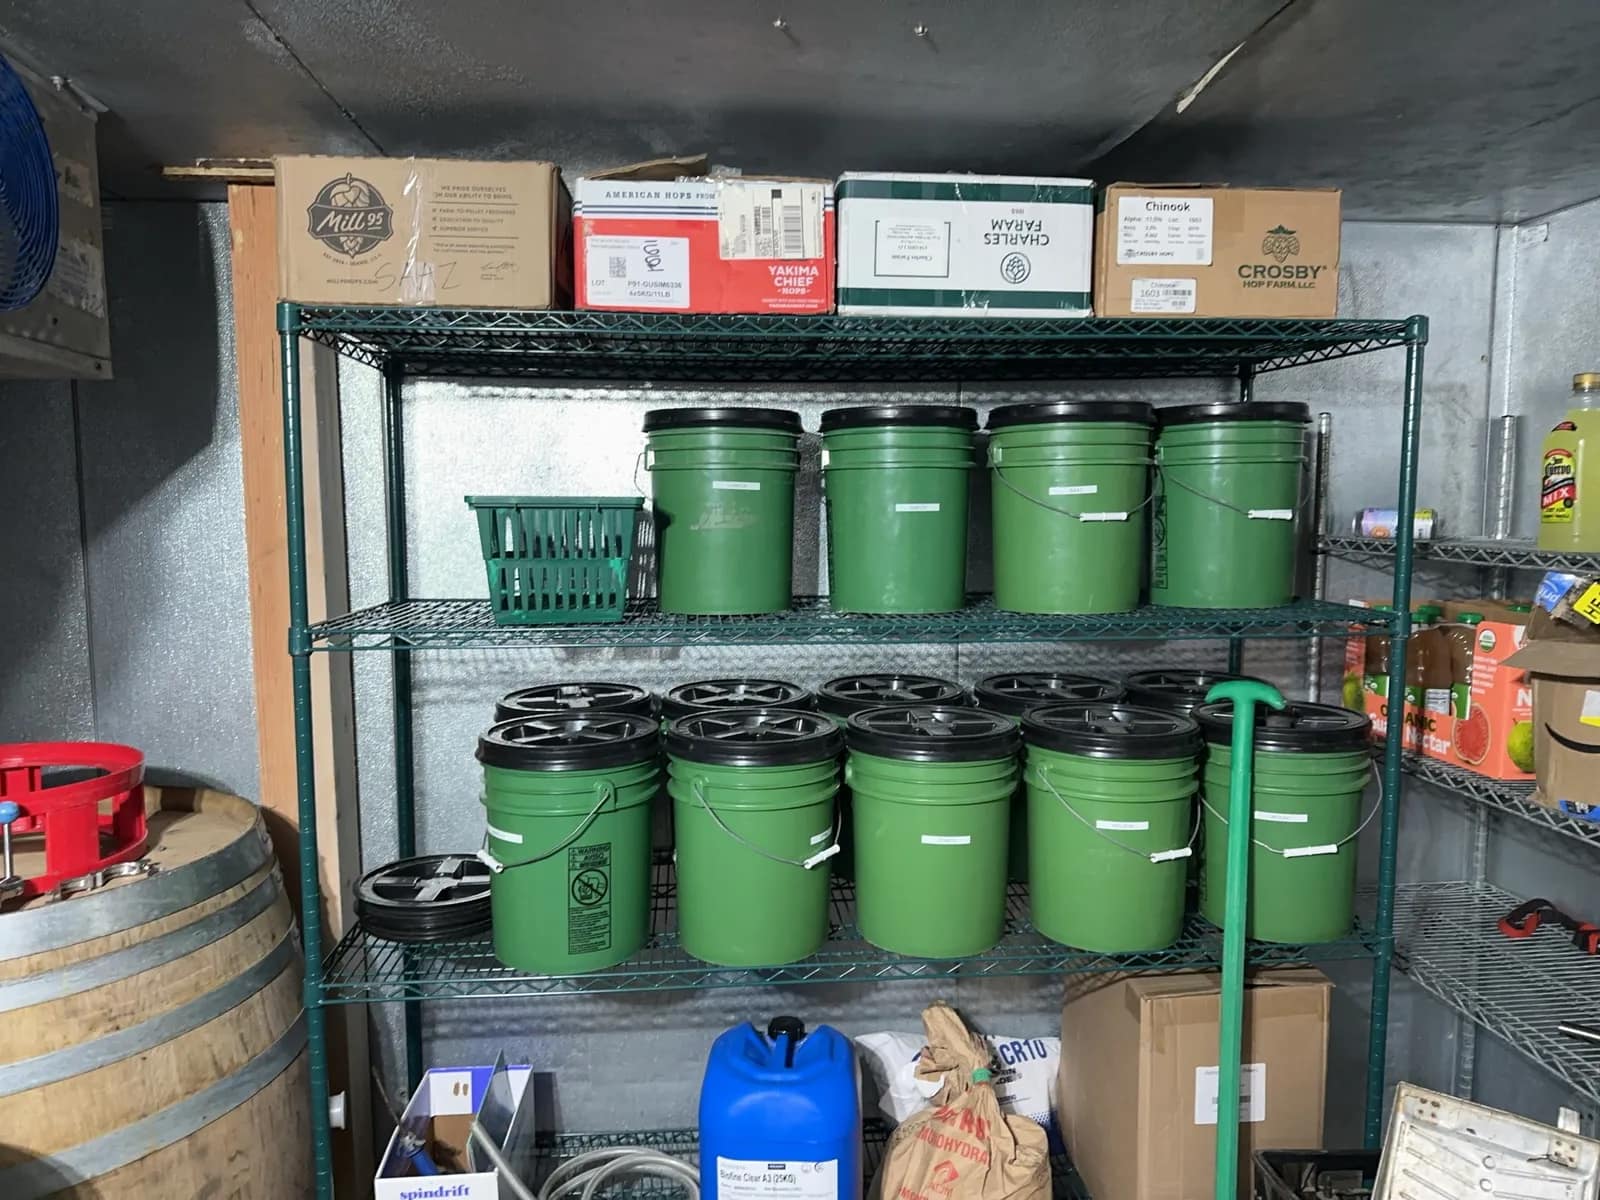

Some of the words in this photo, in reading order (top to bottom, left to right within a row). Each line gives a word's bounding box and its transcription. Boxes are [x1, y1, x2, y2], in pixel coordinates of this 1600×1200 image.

[605, 191, 661, 200] AMERICAN
[665, 191, 692, 200] HOPS
[1145, 201, 1190, 212] Chinook
[316, 210, 366, 233] Mill
[367, 212, 384, 227] 95
[991, 218, 1042, 232] FARAM
[983, 232, 1050, 246] CHARLES
[768, 265, 819, 276] YAKIMA
[774, 276, 814, 287] CHIEF
[1243, 280, 1265, 289] HOP
[1298, 281, 1316, 289] LLC
[400, 1184, 470, 1200] spindrift
